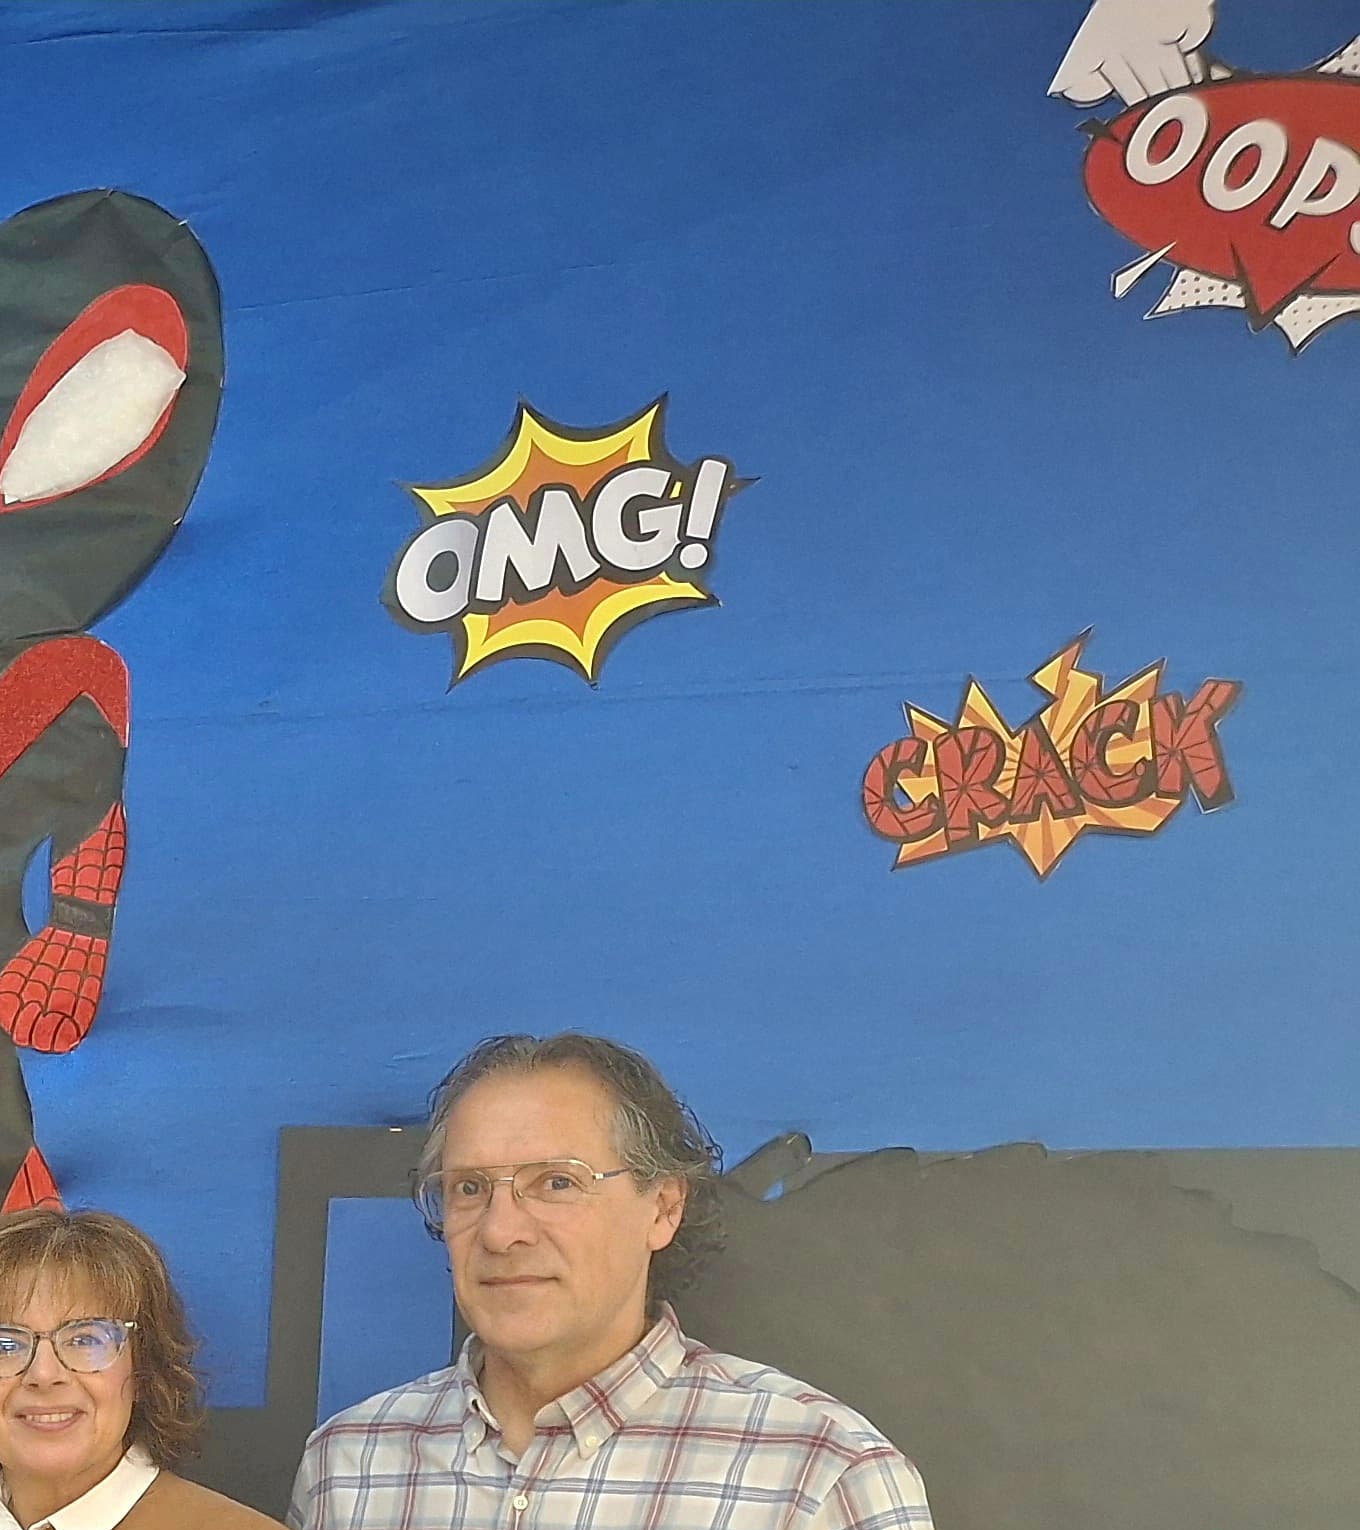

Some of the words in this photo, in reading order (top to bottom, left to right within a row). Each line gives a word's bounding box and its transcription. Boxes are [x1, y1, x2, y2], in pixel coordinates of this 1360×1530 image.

[1125, 92, 1360, 256] OOP
[395, 457, 729, 624] OMG!
[862, 679, 1241, 845] CRACK
